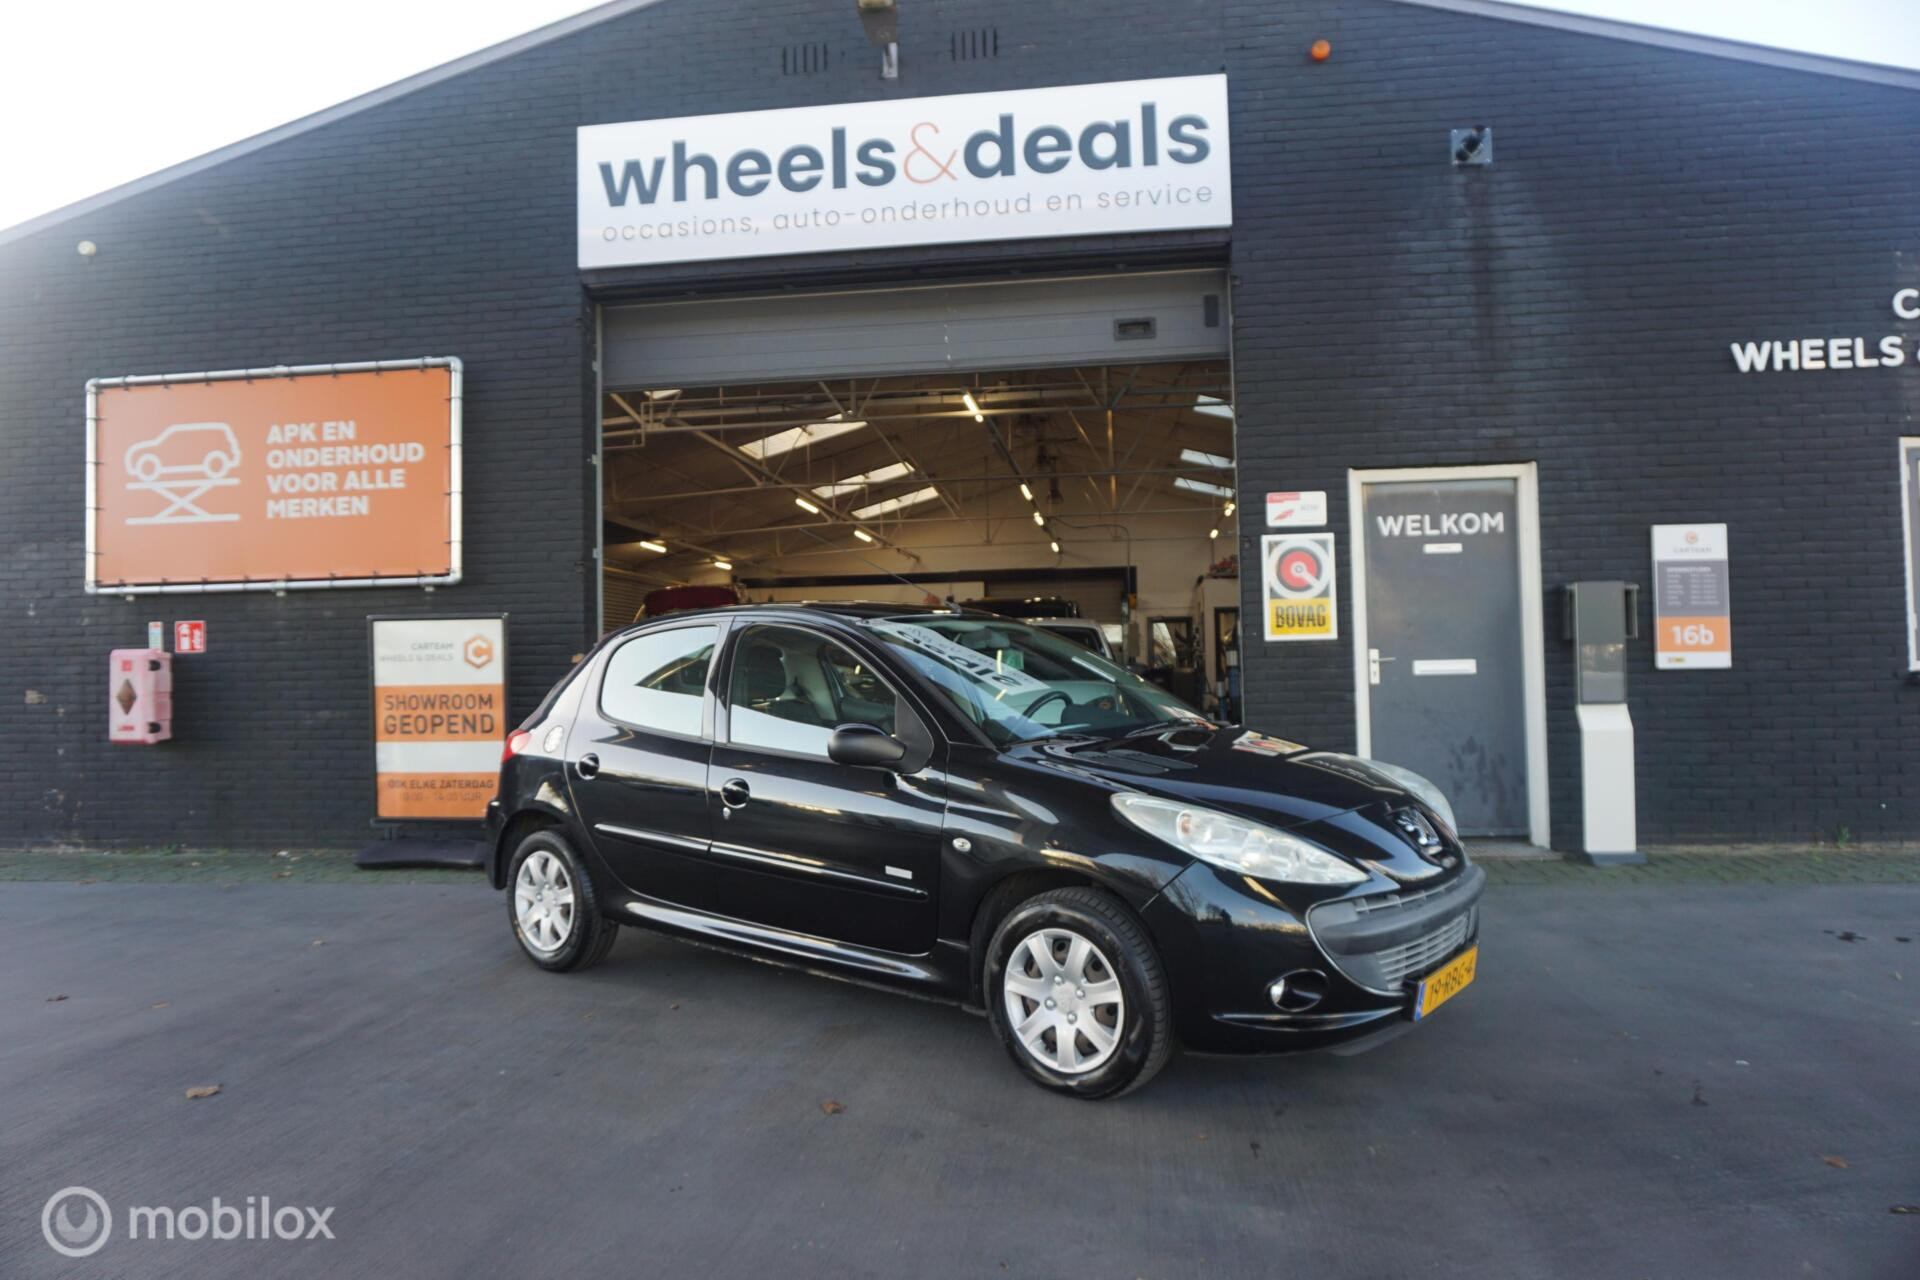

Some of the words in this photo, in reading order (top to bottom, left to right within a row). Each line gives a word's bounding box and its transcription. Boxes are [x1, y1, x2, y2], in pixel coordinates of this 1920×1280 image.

[597, 102, 1211, 208] wheels&deals
[602, 211, 761, 243] occasions,
[772, 191, 1031, 231] auto-onderhoud
[1046, 193, 1083, 213] en
[1098, 184, 1213, 209] service
[1730, 335, 1905, 373] WHEELS
[266, 422, 316, 444] APK
[323, 420, 355, 440] EN
[266, 441, 425, 468] ONDERHOUD
[266, 471, 337, 494] VOOR
[343, 468, 406, 489] ALLE
[266, 495, 369, 520] MERKEN
[1377, 511, 1504, 537] WELKOM
[1275, 603, 1327, 629] BOVAG
[1671, 624, 1714, 646] 16b
[384, 693, 494, 711] SHOWROOM
[384, 713, 495, 734] GEOPEND
[440, 778, 494, 789] ZATERDAG
